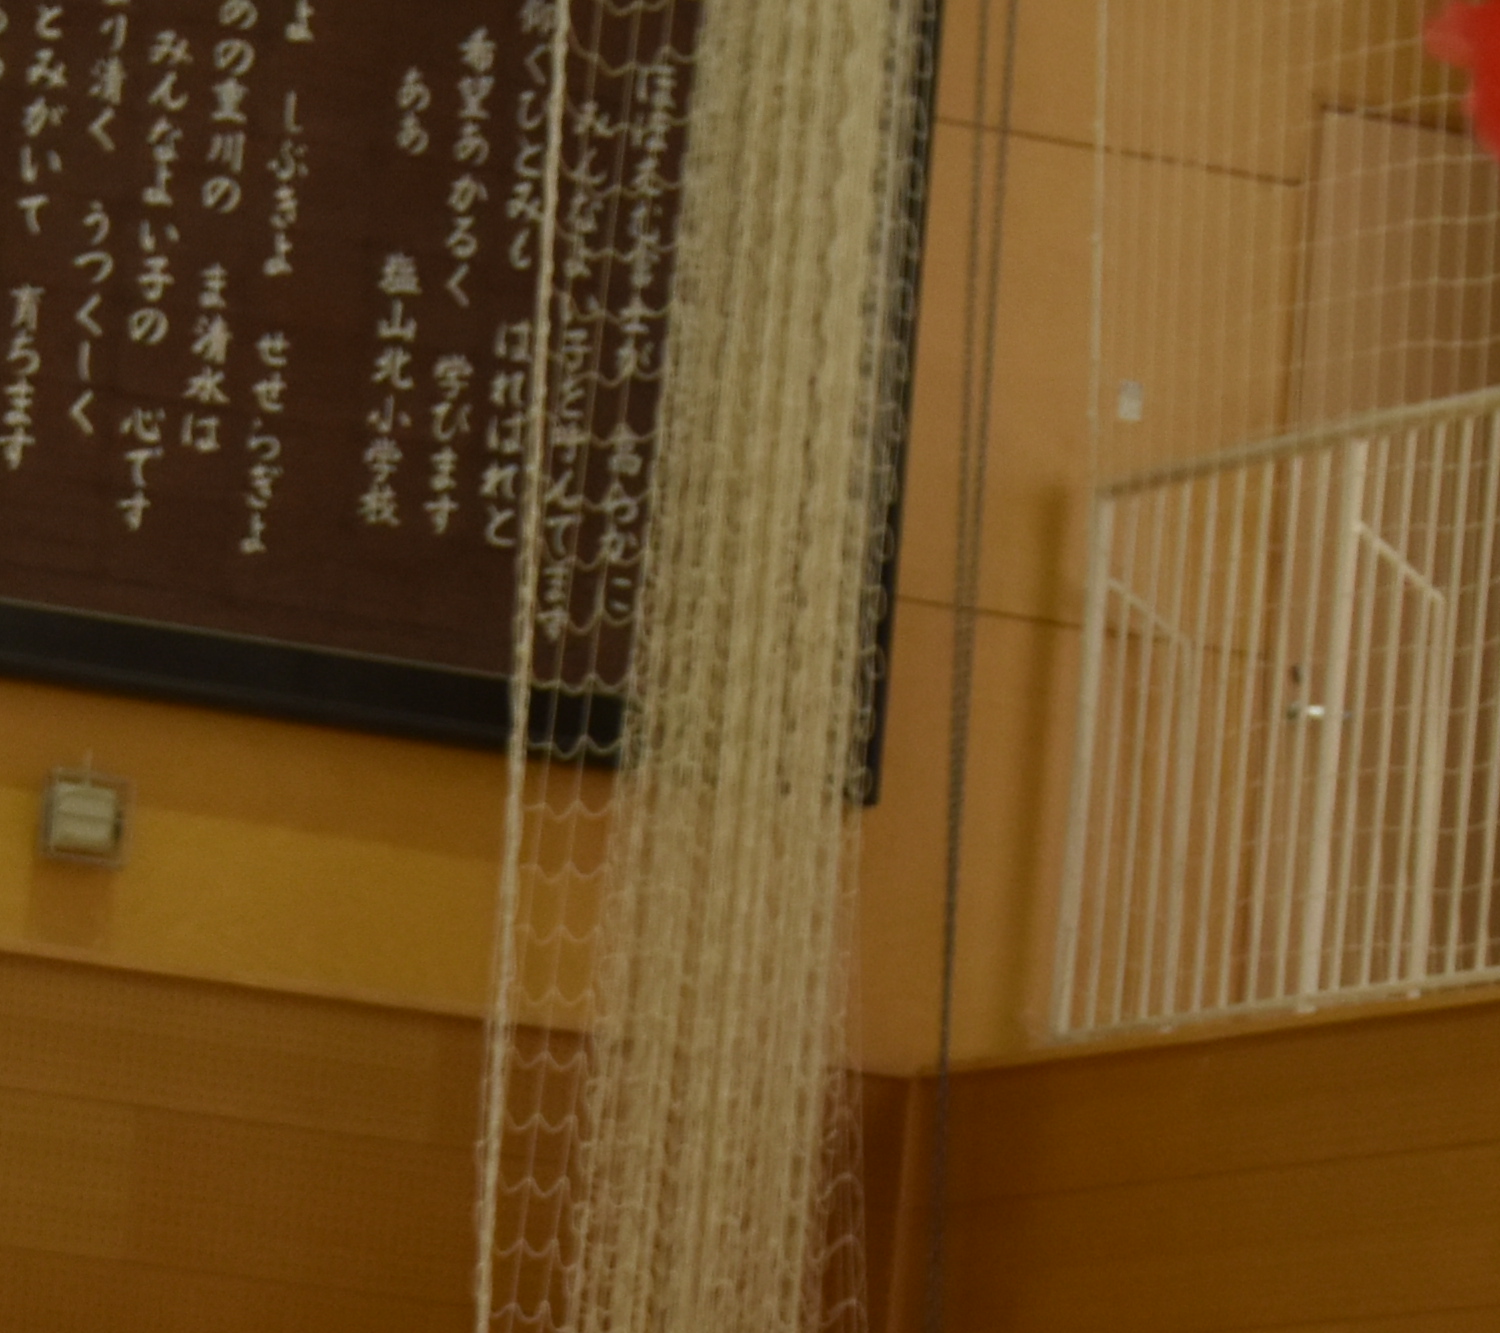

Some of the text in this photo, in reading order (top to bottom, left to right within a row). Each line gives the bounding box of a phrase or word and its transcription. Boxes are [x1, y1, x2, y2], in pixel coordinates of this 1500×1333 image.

[264, 92, 308, 276] しぶきよ
[398, 68, 430, 153] ああ
[69, 201, 113, 434] うつくしく
[119, 30, 192, 529] みんなよい子の 心です
[425, 28, 495, 533] 希望あかるく 学びます
[241, 333, 289, 553] せせらぎよ
